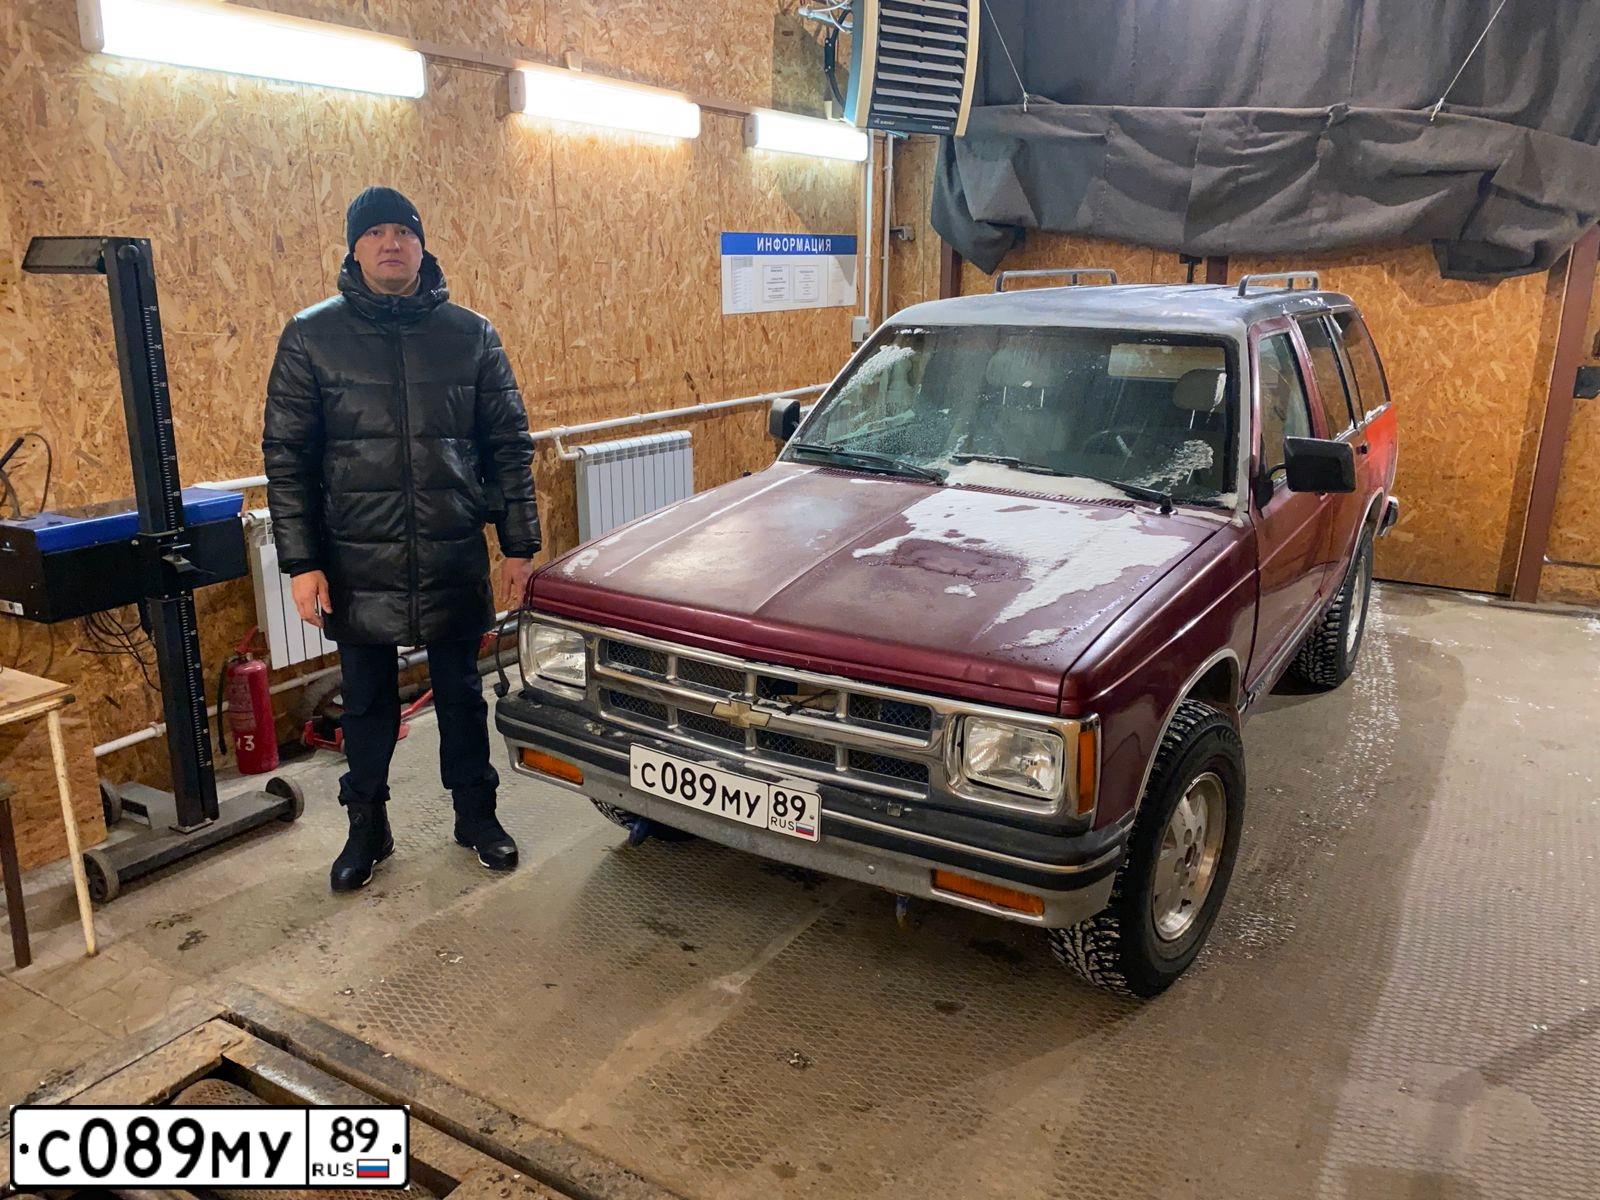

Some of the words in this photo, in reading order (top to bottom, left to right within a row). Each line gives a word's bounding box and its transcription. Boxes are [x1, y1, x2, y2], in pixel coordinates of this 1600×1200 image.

[757, 237, 832, 254] ИНФОРМАЦИЯ
[773, 790, 806, 822] 89
[770, 816, 795, 831] RUS
